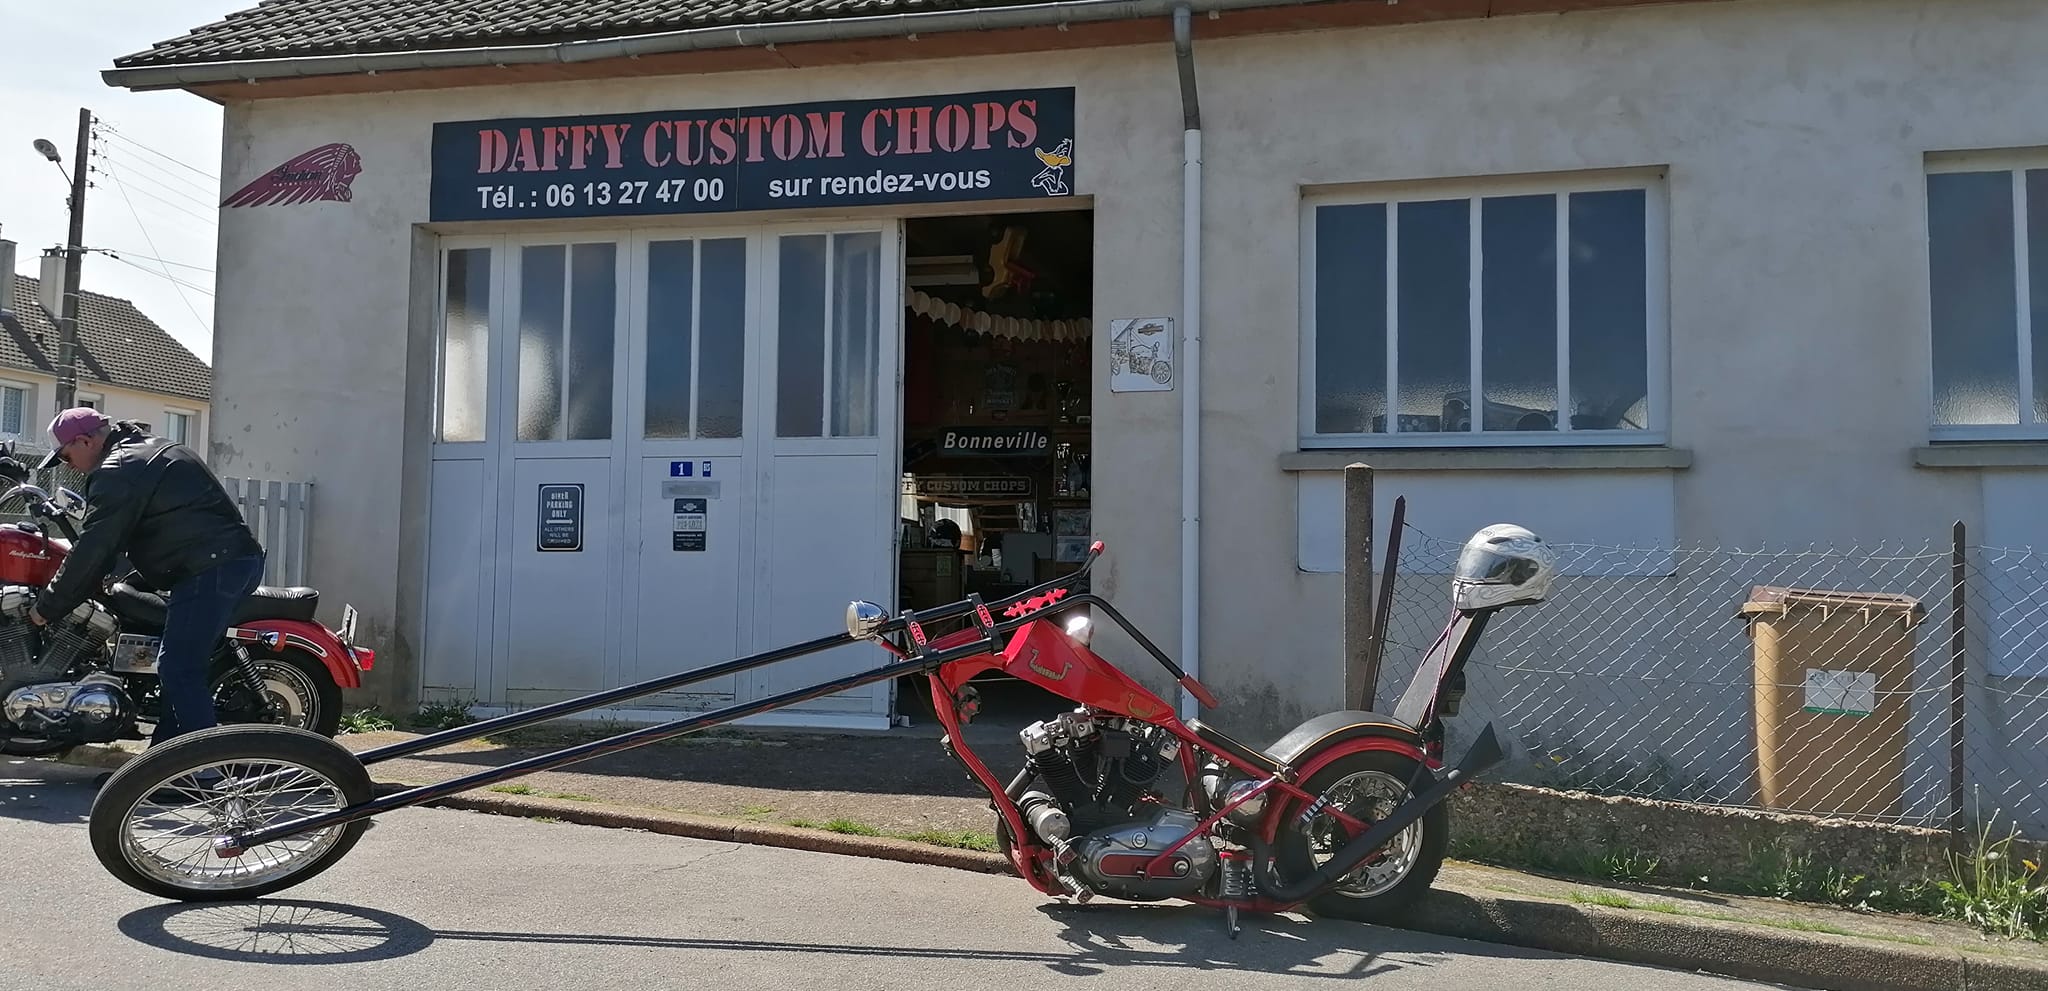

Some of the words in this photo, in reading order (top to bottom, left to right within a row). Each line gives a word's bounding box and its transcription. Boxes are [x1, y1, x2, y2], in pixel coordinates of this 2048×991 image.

[478, 123, 631, 174] DAFFY
[643, 111, 846, 168] CUSTOM
[861, 99, 1038, 157] CHOPS
[768, 176, 812, 197] sur
[820, 169, 991, 195] rendez-vous
[546, 184, 575, 208] 06
[583, 182, 612, 206] 13
[618, 181, 649, 205] 27
[655, 179, 686, 203] 47
[693, 178, 724, 202] 00
[944, 431, 1048, 449] Bonneville
[678, 462, 685, 476] 1
[927, 480, 981, 491] CUSTOM
[984, 480, 1026, 491] CHOPS
[546, 500, 573, 509] PARKING
[551, 509, 567, 518] ONLY
